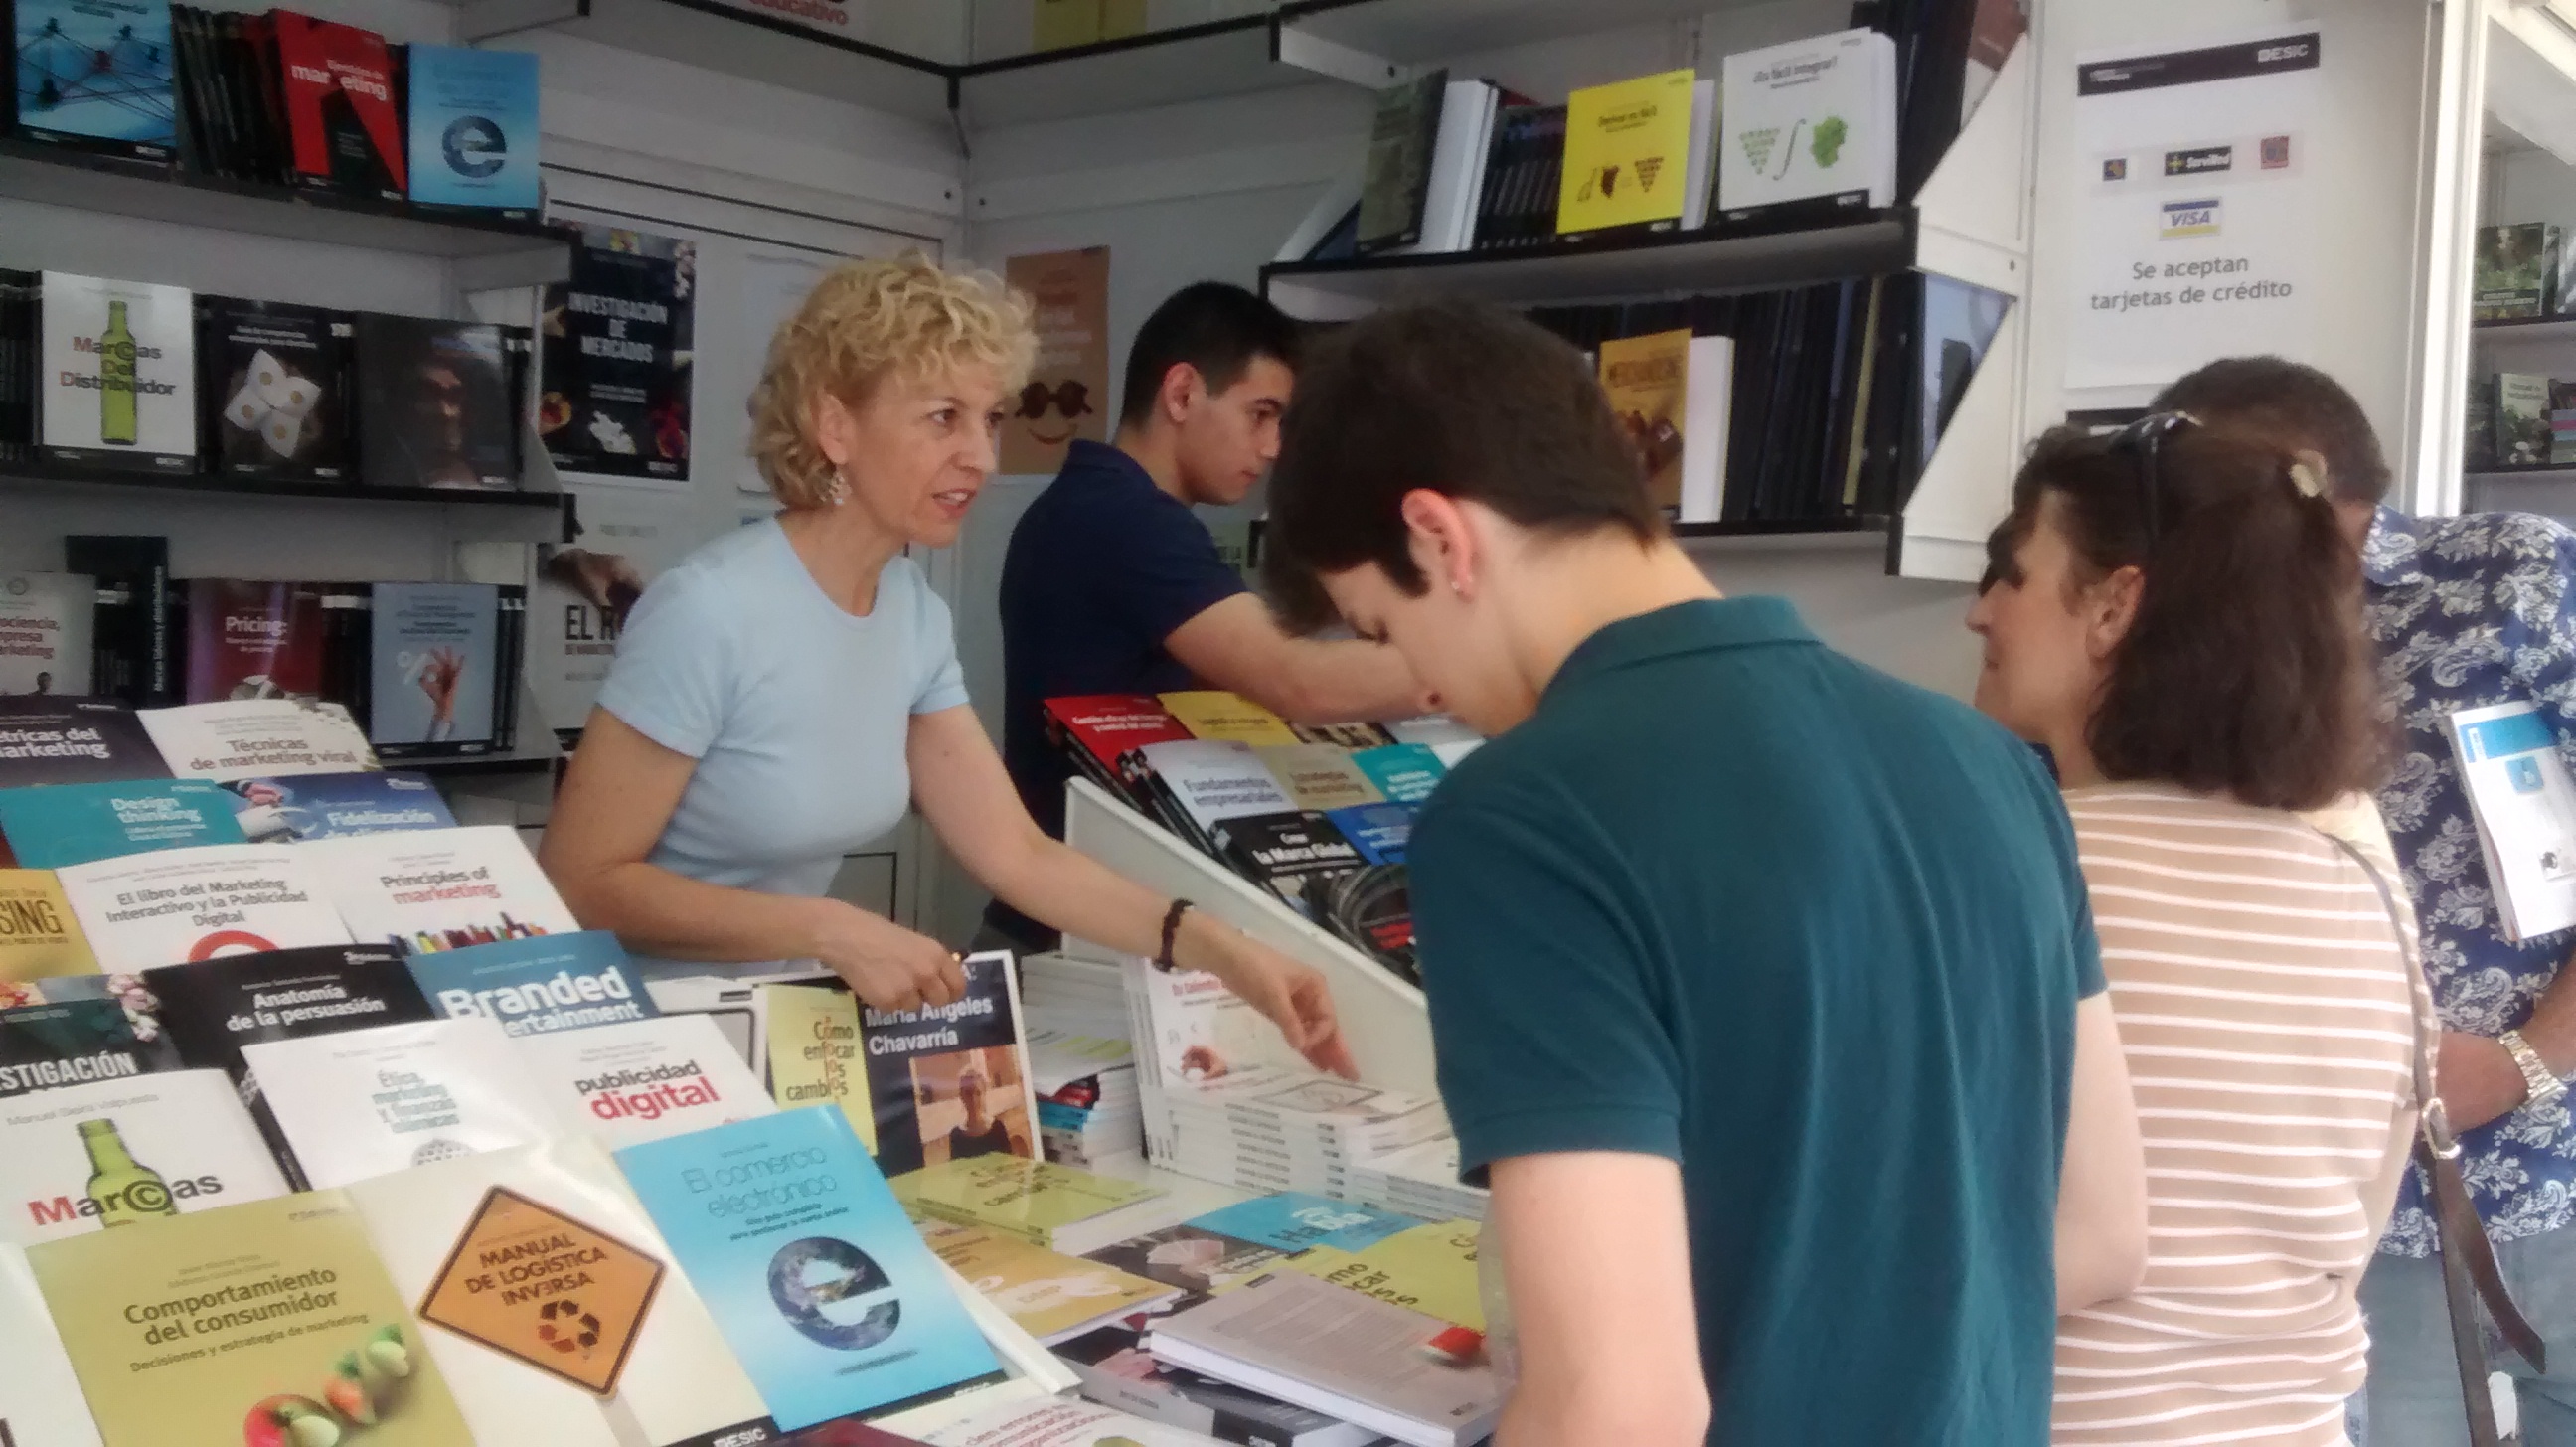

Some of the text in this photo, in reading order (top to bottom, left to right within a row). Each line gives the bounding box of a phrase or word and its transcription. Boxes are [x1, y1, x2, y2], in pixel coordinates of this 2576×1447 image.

[2271, 43, 2309, 61] ESIC
[2170, 210, 2211, 227] VISA
[2132, 255, 2249, 280] Se aceptan
[2090, 281, 2293, 312] tarjetas de crédito
[581, 336, 654, 364] MERCADOS
[60, 370, 177, 397] Distribuidor
[566, 604, 594, 641] EL
[66, 726, 102, 742] del
[226, 737, 309, 753] Técnicas
[0, 740, 111, 760] arketing
[190, 749, 358, 771] de marketing viral
[110, 796, 181, 813] Design
[116, 877, 288, 906] El libro del Marketing
[380, 865, 490, 889] Principles of
[106, 889, 309, 924] Interactivo y la Publicidad
[392, 882, 502, 905] marketing
[0, 899, 65, 936] SING
[192, 909, 246, 928] Digital
[252, 983, 348, 1011] Anatomía
[436, 964, 632, 1020] Branded
[227, 996, 387, 1033] de la persuasión
[503, 1000, 644, 1037] ertainment
[869, 1026, 960, 1056] Chavarría
[0, 1049, 139, 1091] STIGACIÓN
[574, 1059, 703, 1096] publicidad
[589, 1076, 723, 1121] digital
[681, 1146, 828, 1194] El comercio
[707, 1173, 838, 1219] electrónico
[479, 1232, 577, 1269] MANUAL
[123, 1266, 339, 1326] Comportamiento
[464, 1274, 497, 1295] DE
[501, 1270, 596, 1307] INVERSA
[145, 1289, 340, 1347] del consumidor
[130, 1346, 206, 1373] Decisiones
[220, 1327, 286, 1353] estrategia
[288, 1325, 305, 1337] de
[307, 1311, 371, 1334] marketing
[726, 1427, 767, 1447] ESIC
